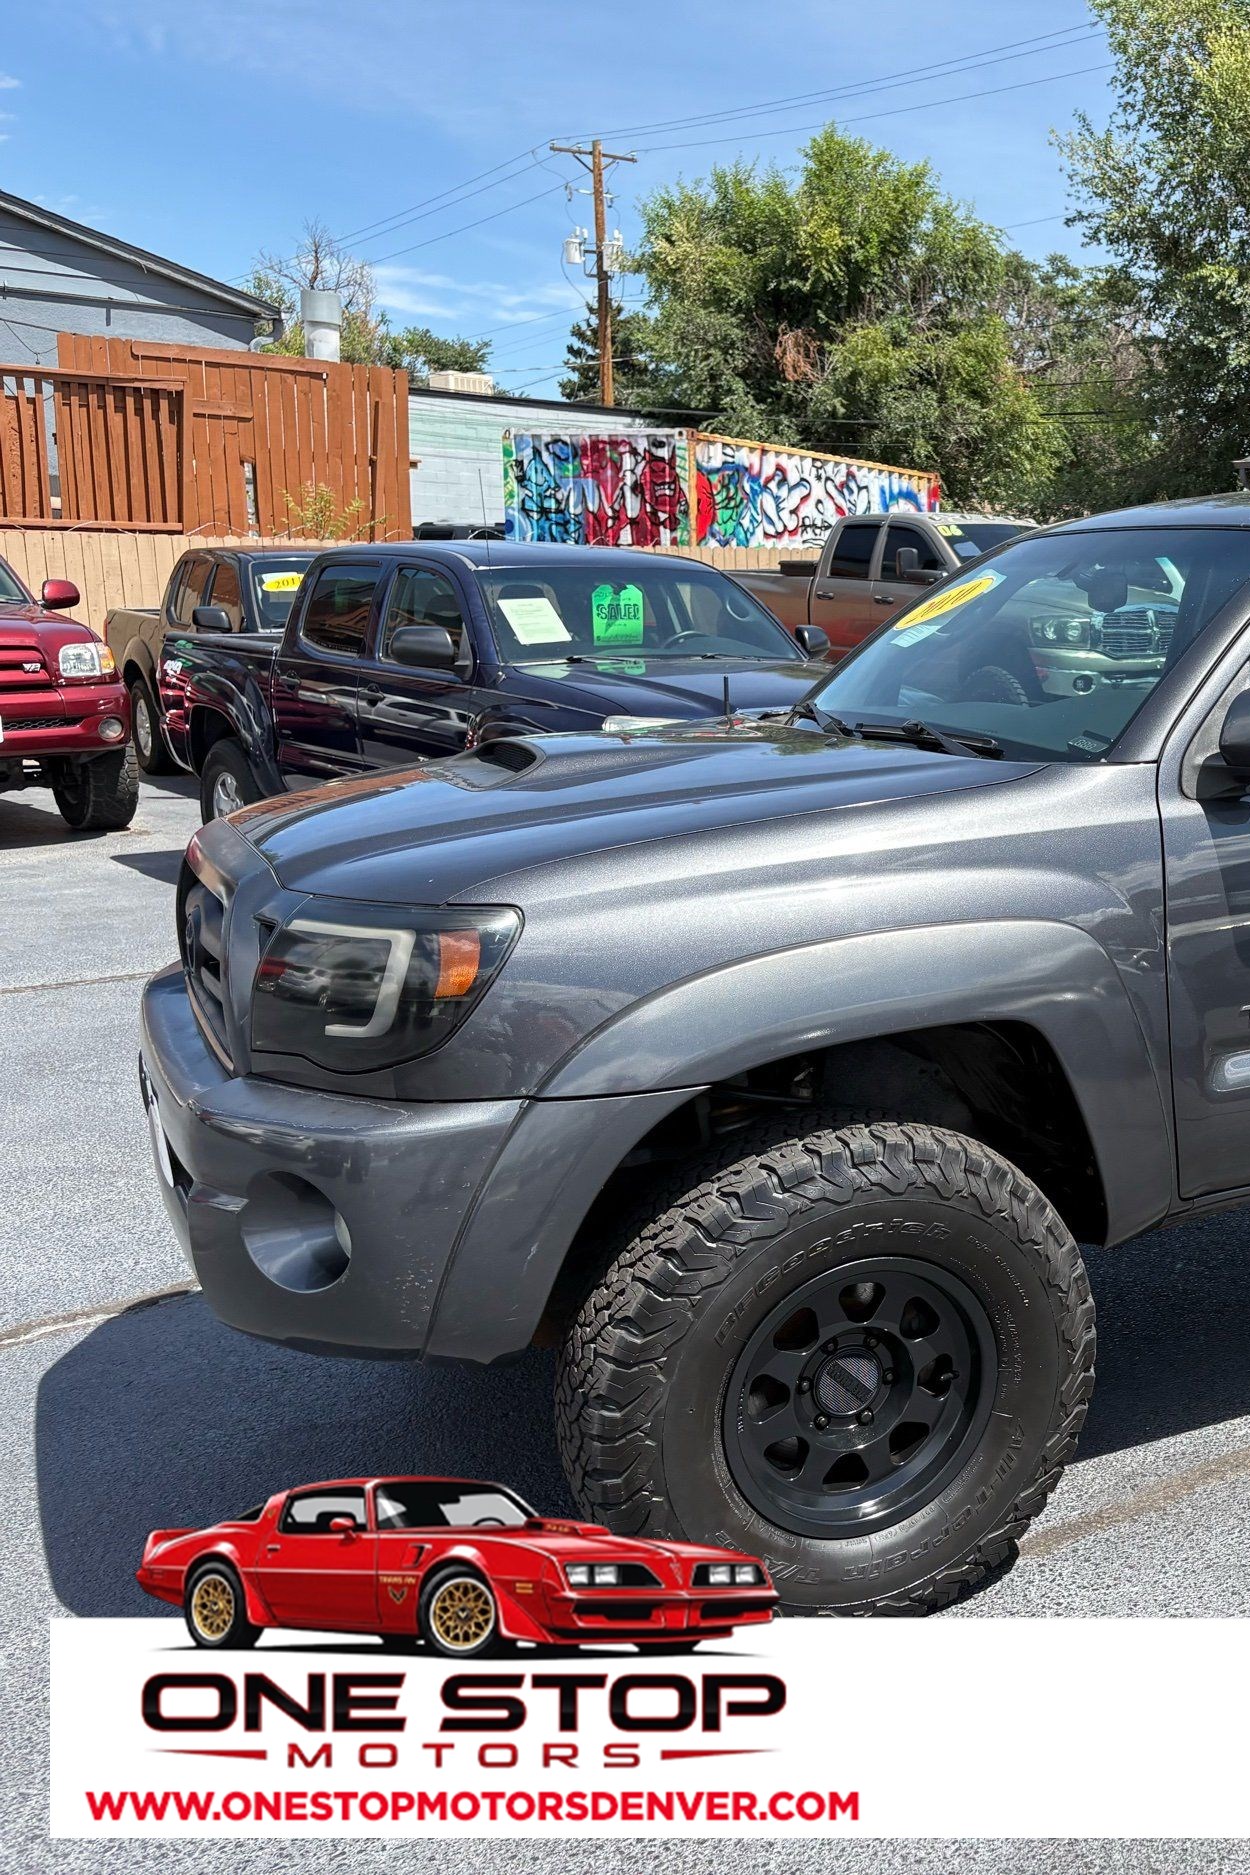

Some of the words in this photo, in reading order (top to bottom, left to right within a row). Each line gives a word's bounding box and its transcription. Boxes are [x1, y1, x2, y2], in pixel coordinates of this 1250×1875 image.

[936, 524, 964, 537] 06
[596, 603, 640, 620] SALE!
[713, 1219, 951, 1347] BFGoodrich
